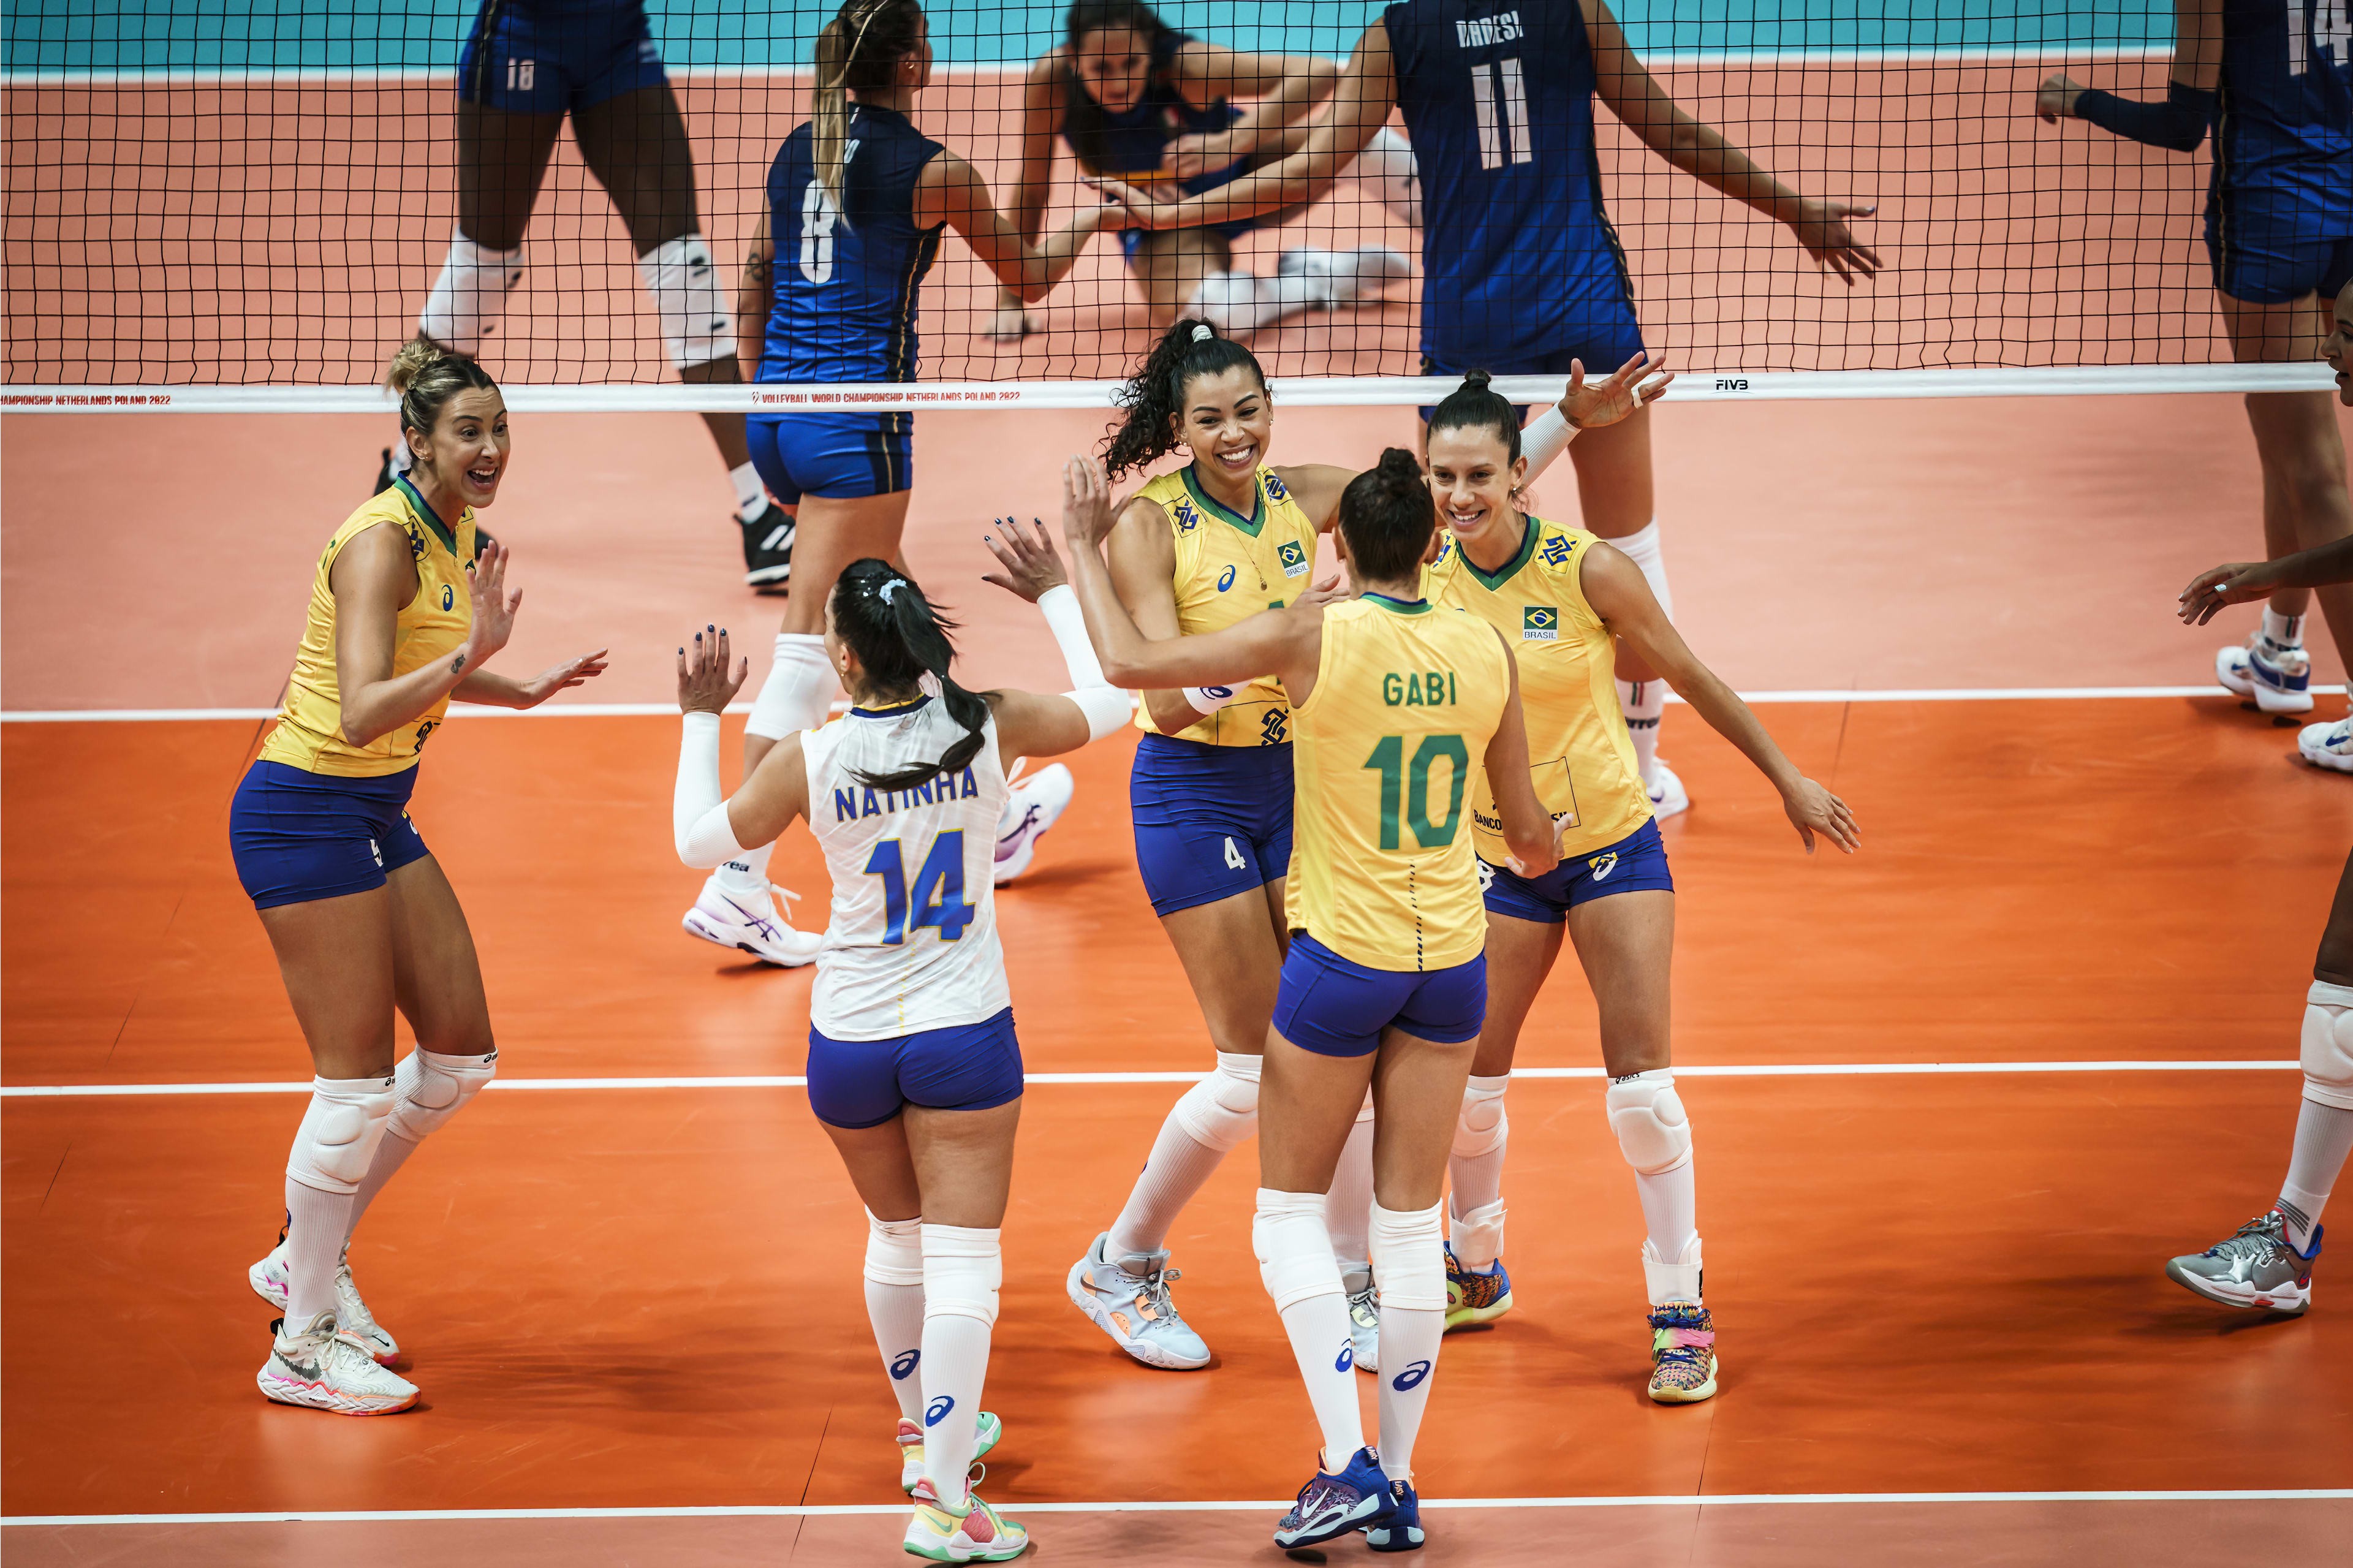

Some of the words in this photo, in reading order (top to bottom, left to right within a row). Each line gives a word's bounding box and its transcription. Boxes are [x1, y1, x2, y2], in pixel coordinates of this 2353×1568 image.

[507, 58, 535, 91] 18
[1471, 58, 1532, 170] 11
[800, 179, 836, 284] 8
[56, 395, 112, 405] NETHERLANDS
[115, 395, 146, 405] POLAND
[149, 395, 171, 405] 2022
[762, 394, 808, 403] VOLLEYBALL
[812, 393, 841, 403] WORLD
[844, 393, 903, 403] CHAMPIONSHIP
[906, 392, 961, 401] NETHERLANDS
[965, 392, 996, 401] POLAND
[999, 392, 1020, 401] 2022
[1716, 379, 1748, 390] FIVB
[1286, 564, 1308, 577] BRASIL
[1383, 672, 1456, 706] GABI
[835, 765, 979, 822] NATINHA
[1363, 734, 1469, 850] 10
[1474, 809, 1502, 831] BANCO
[1224, 836, 1246, 869] 4
[863, 828, 976, 945] 14
